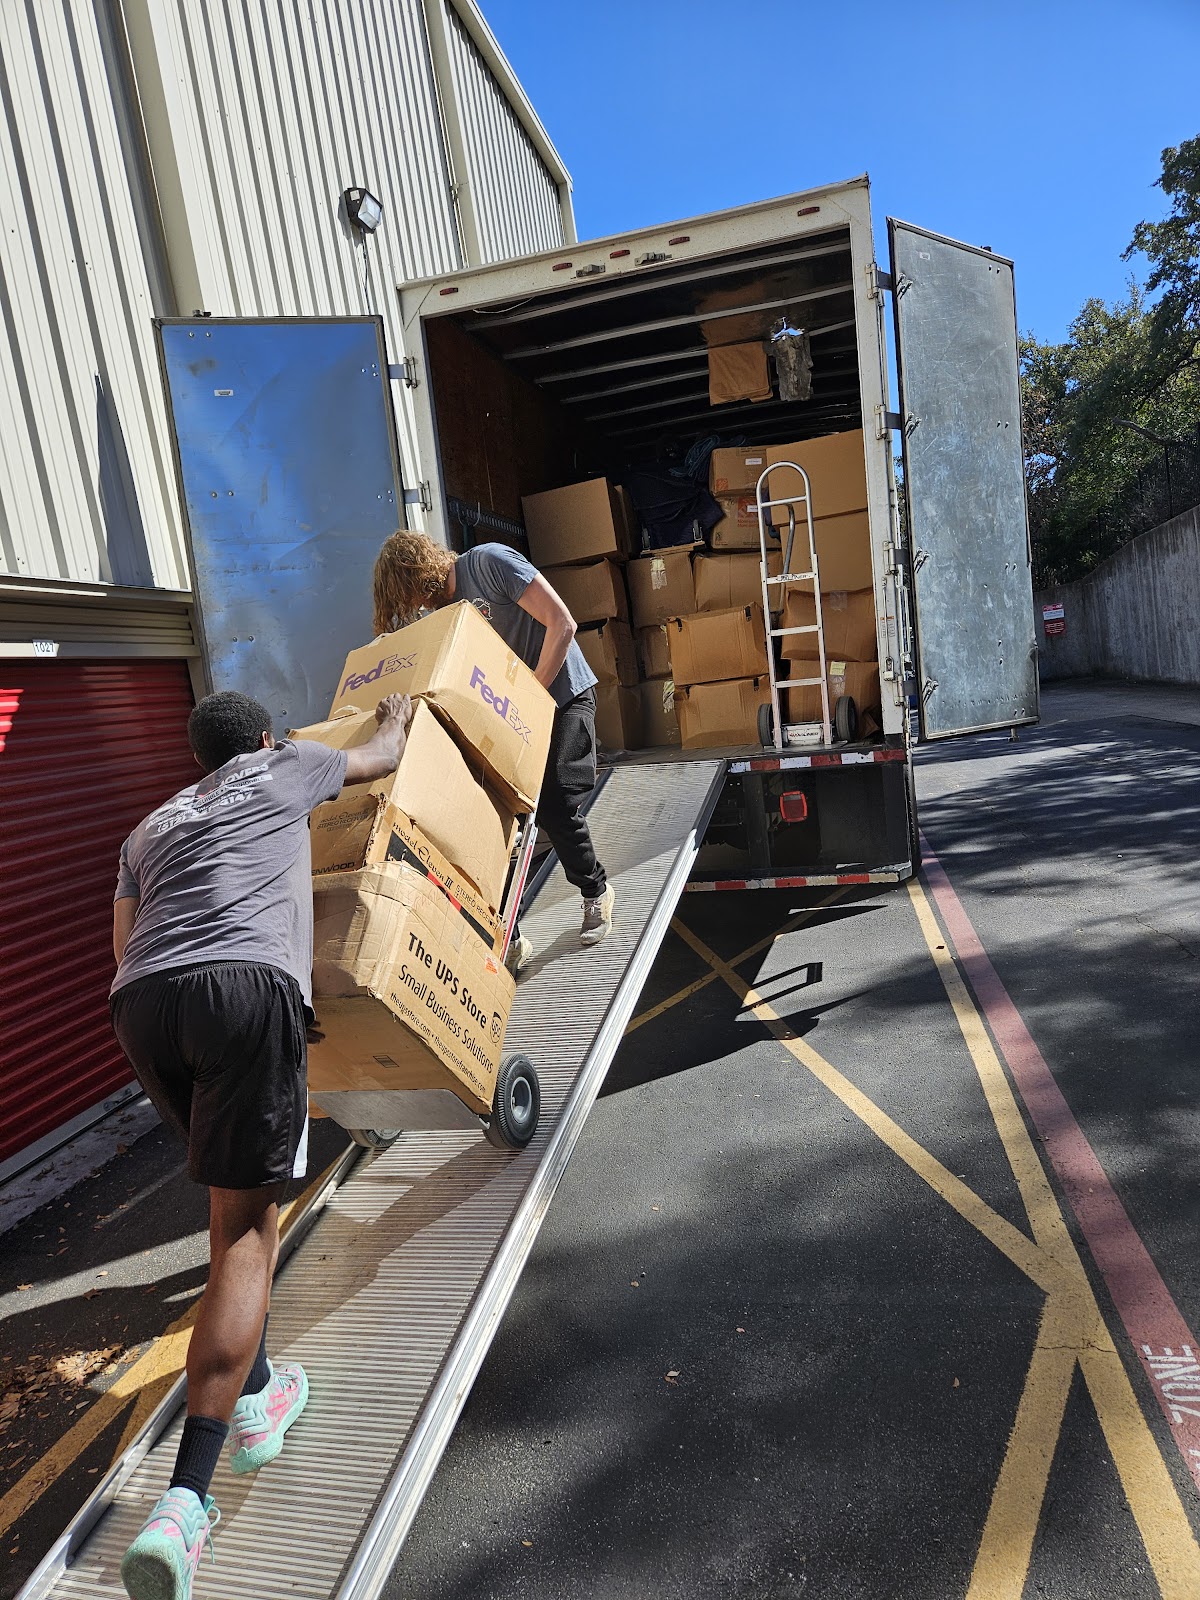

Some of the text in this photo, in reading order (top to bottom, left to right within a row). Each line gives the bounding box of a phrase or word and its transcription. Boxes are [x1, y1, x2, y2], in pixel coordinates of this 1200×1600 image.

[35, 642, 54, 652] 1027
[340, 653, 417, 698] FedEx
[469, 665, 532, 746] FedEx
[220, 764, 269, 787] OVERS
[312, 862, 355, 877] ENWOOD
[393, 822, 418, 850] model
[417, 846, 444, 882] Eleven
[444, 876, 454, 890] III
[455, 885, 476, 908] STEREO
[398, 964, 494, 1074] Small Business Solutions
[408, 932, 433, 968] The
[435, 959, 460, 995] UPS
[460, 987, 487, 1029] Store
[390, 992, 486, 1093] theupsstore.com theupsstorefranchise.com
